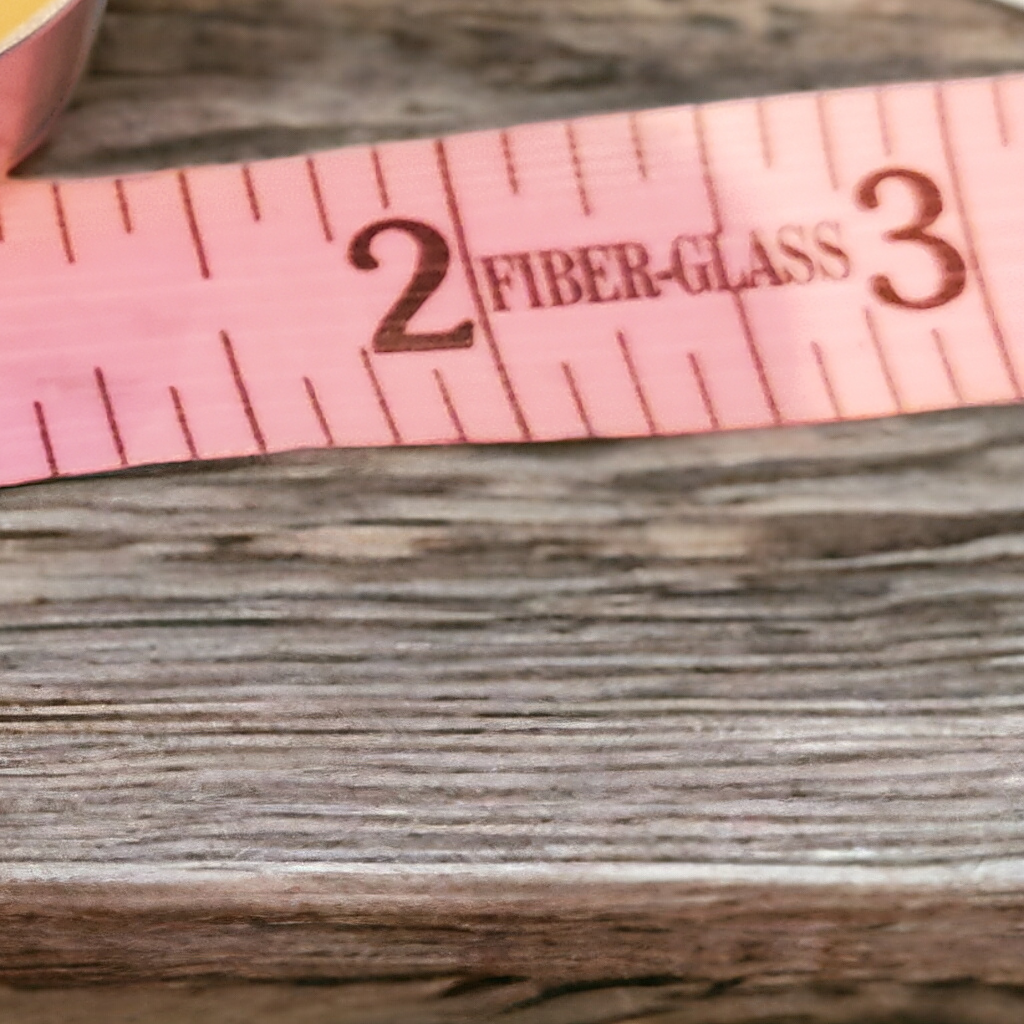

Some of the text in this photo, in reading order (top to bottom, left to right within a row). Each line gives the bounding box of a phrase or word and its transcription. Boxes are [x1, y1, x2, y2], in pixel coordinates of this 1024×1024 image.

[347, 217, 474, 354] 2
[480, 221, 853, 313] FIBER-GLASS
[855, 167, 968, 310] 3
